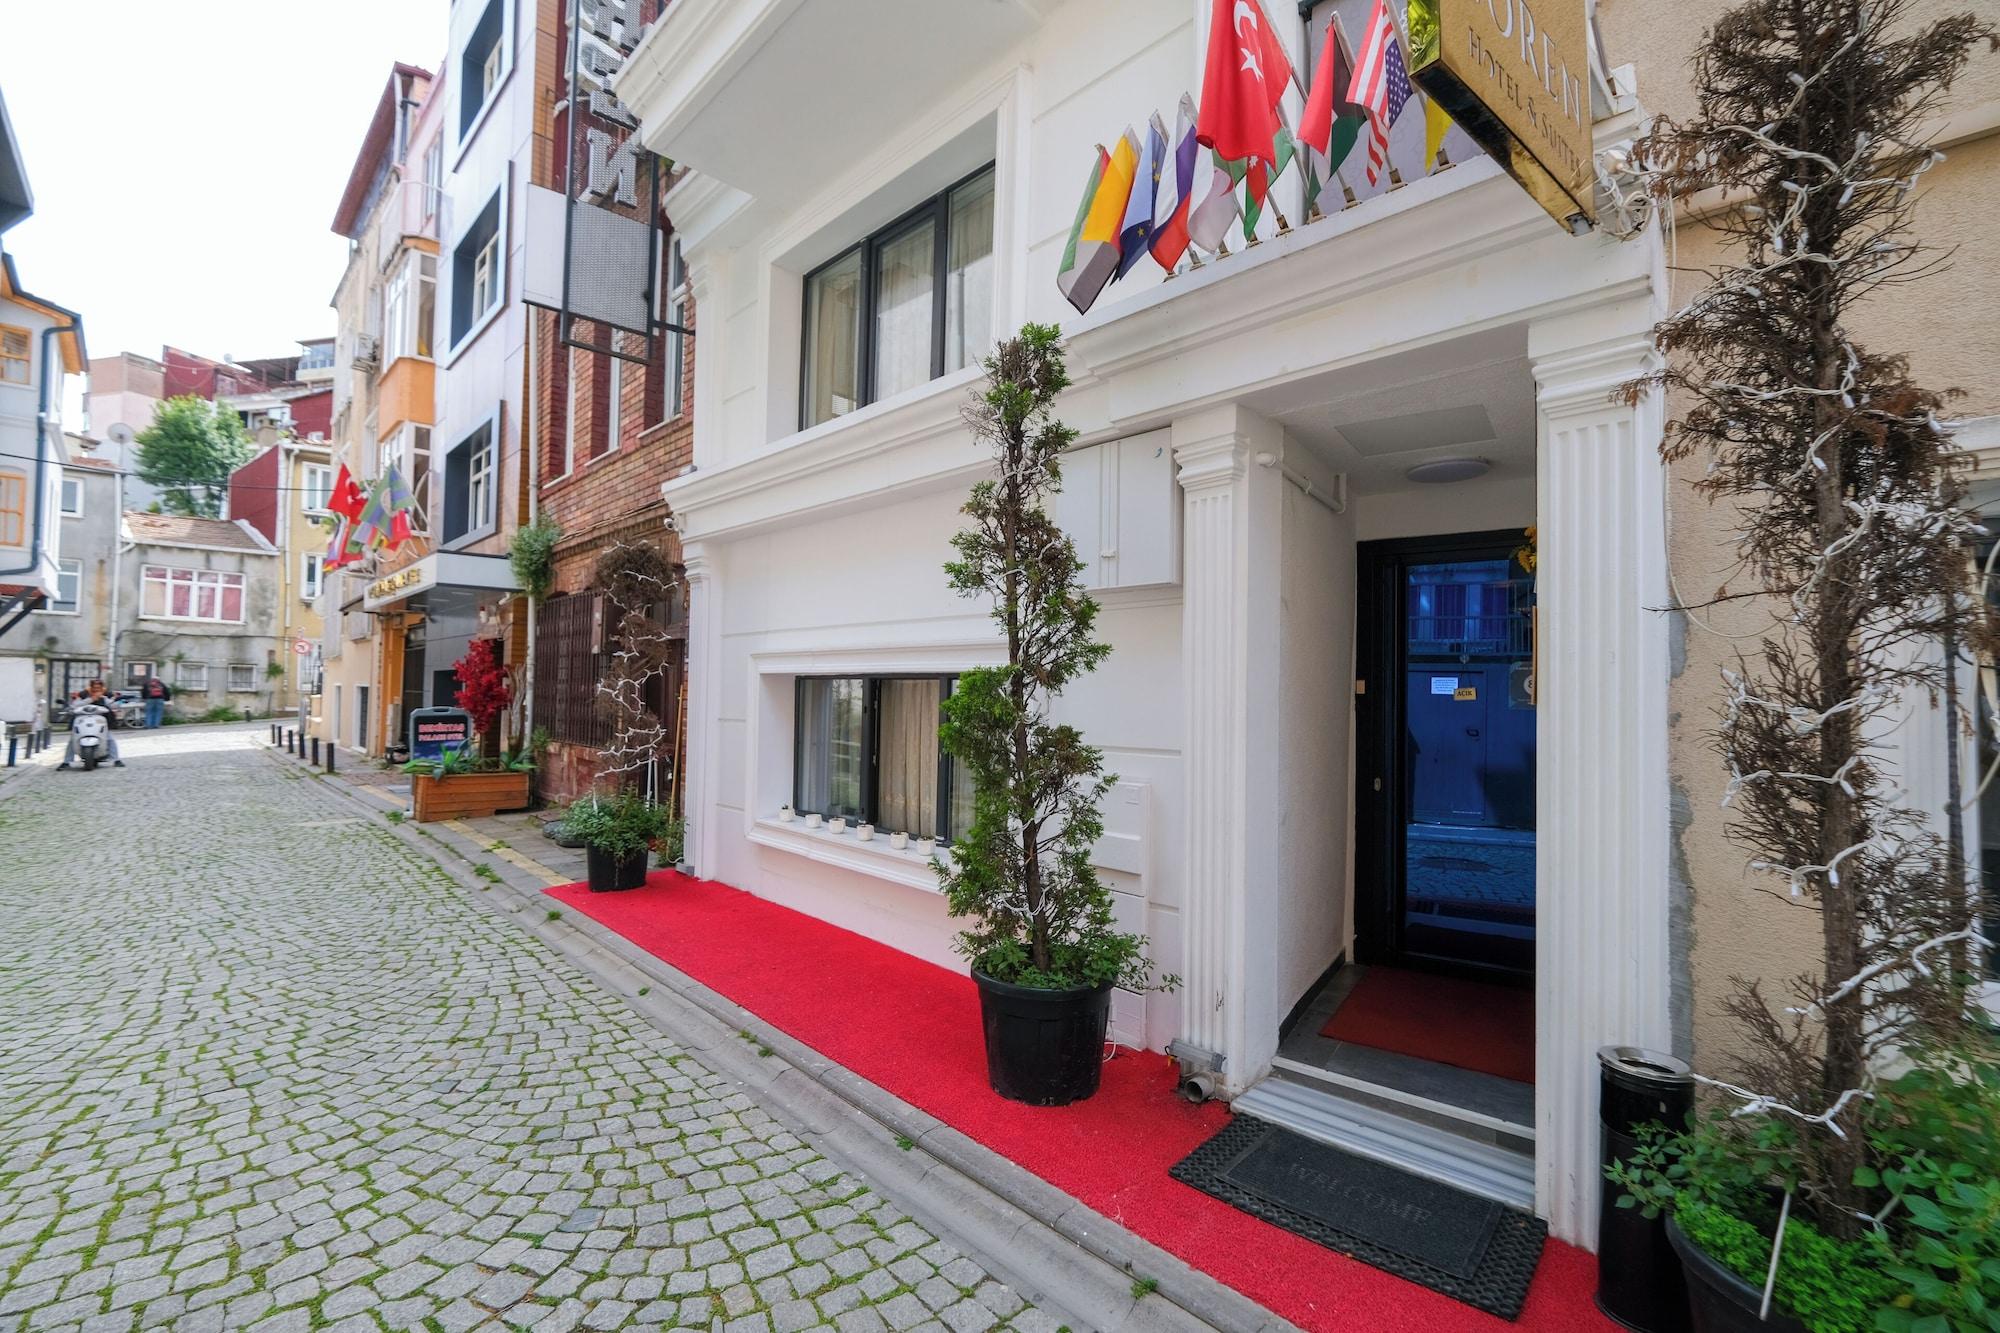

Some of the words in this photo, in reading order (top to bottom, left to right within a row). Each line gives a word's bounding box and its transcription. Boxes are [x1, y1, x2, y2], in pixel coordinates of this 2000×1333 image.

[1468, 25, 1523, 111] HOTEL
[1527, 96, 1538, 129] &
[1541, 112, 1581, 178] SUITES
[1476, 0, 1582, 133] OREN
[1287, 1162, 1433, 1227] WELCOME
